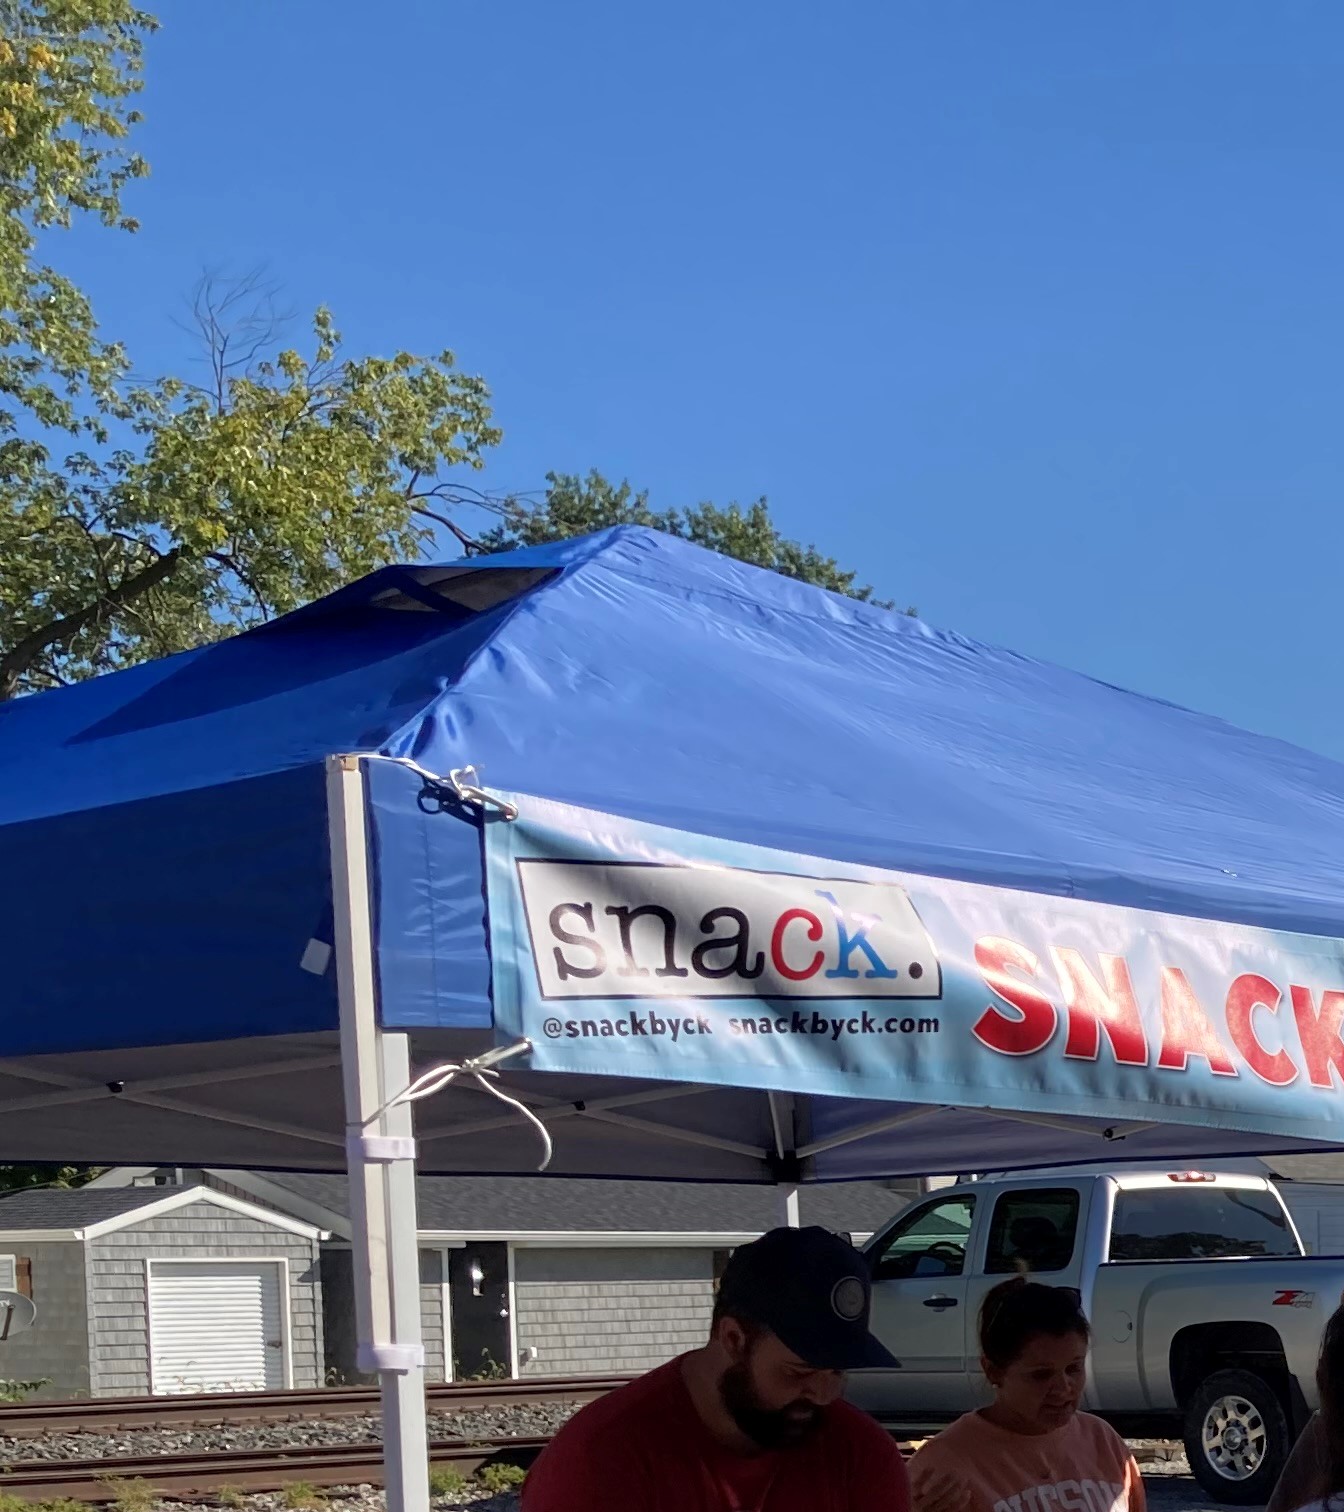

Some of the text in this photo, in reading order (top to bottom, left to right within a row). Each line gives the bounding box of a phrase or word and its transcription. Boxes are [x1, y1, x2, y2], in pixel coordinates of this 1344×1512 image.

[549, 890, 923, 981] snack.
[542, 1010, 940, 1041] @snackbyck snackbyck.com
